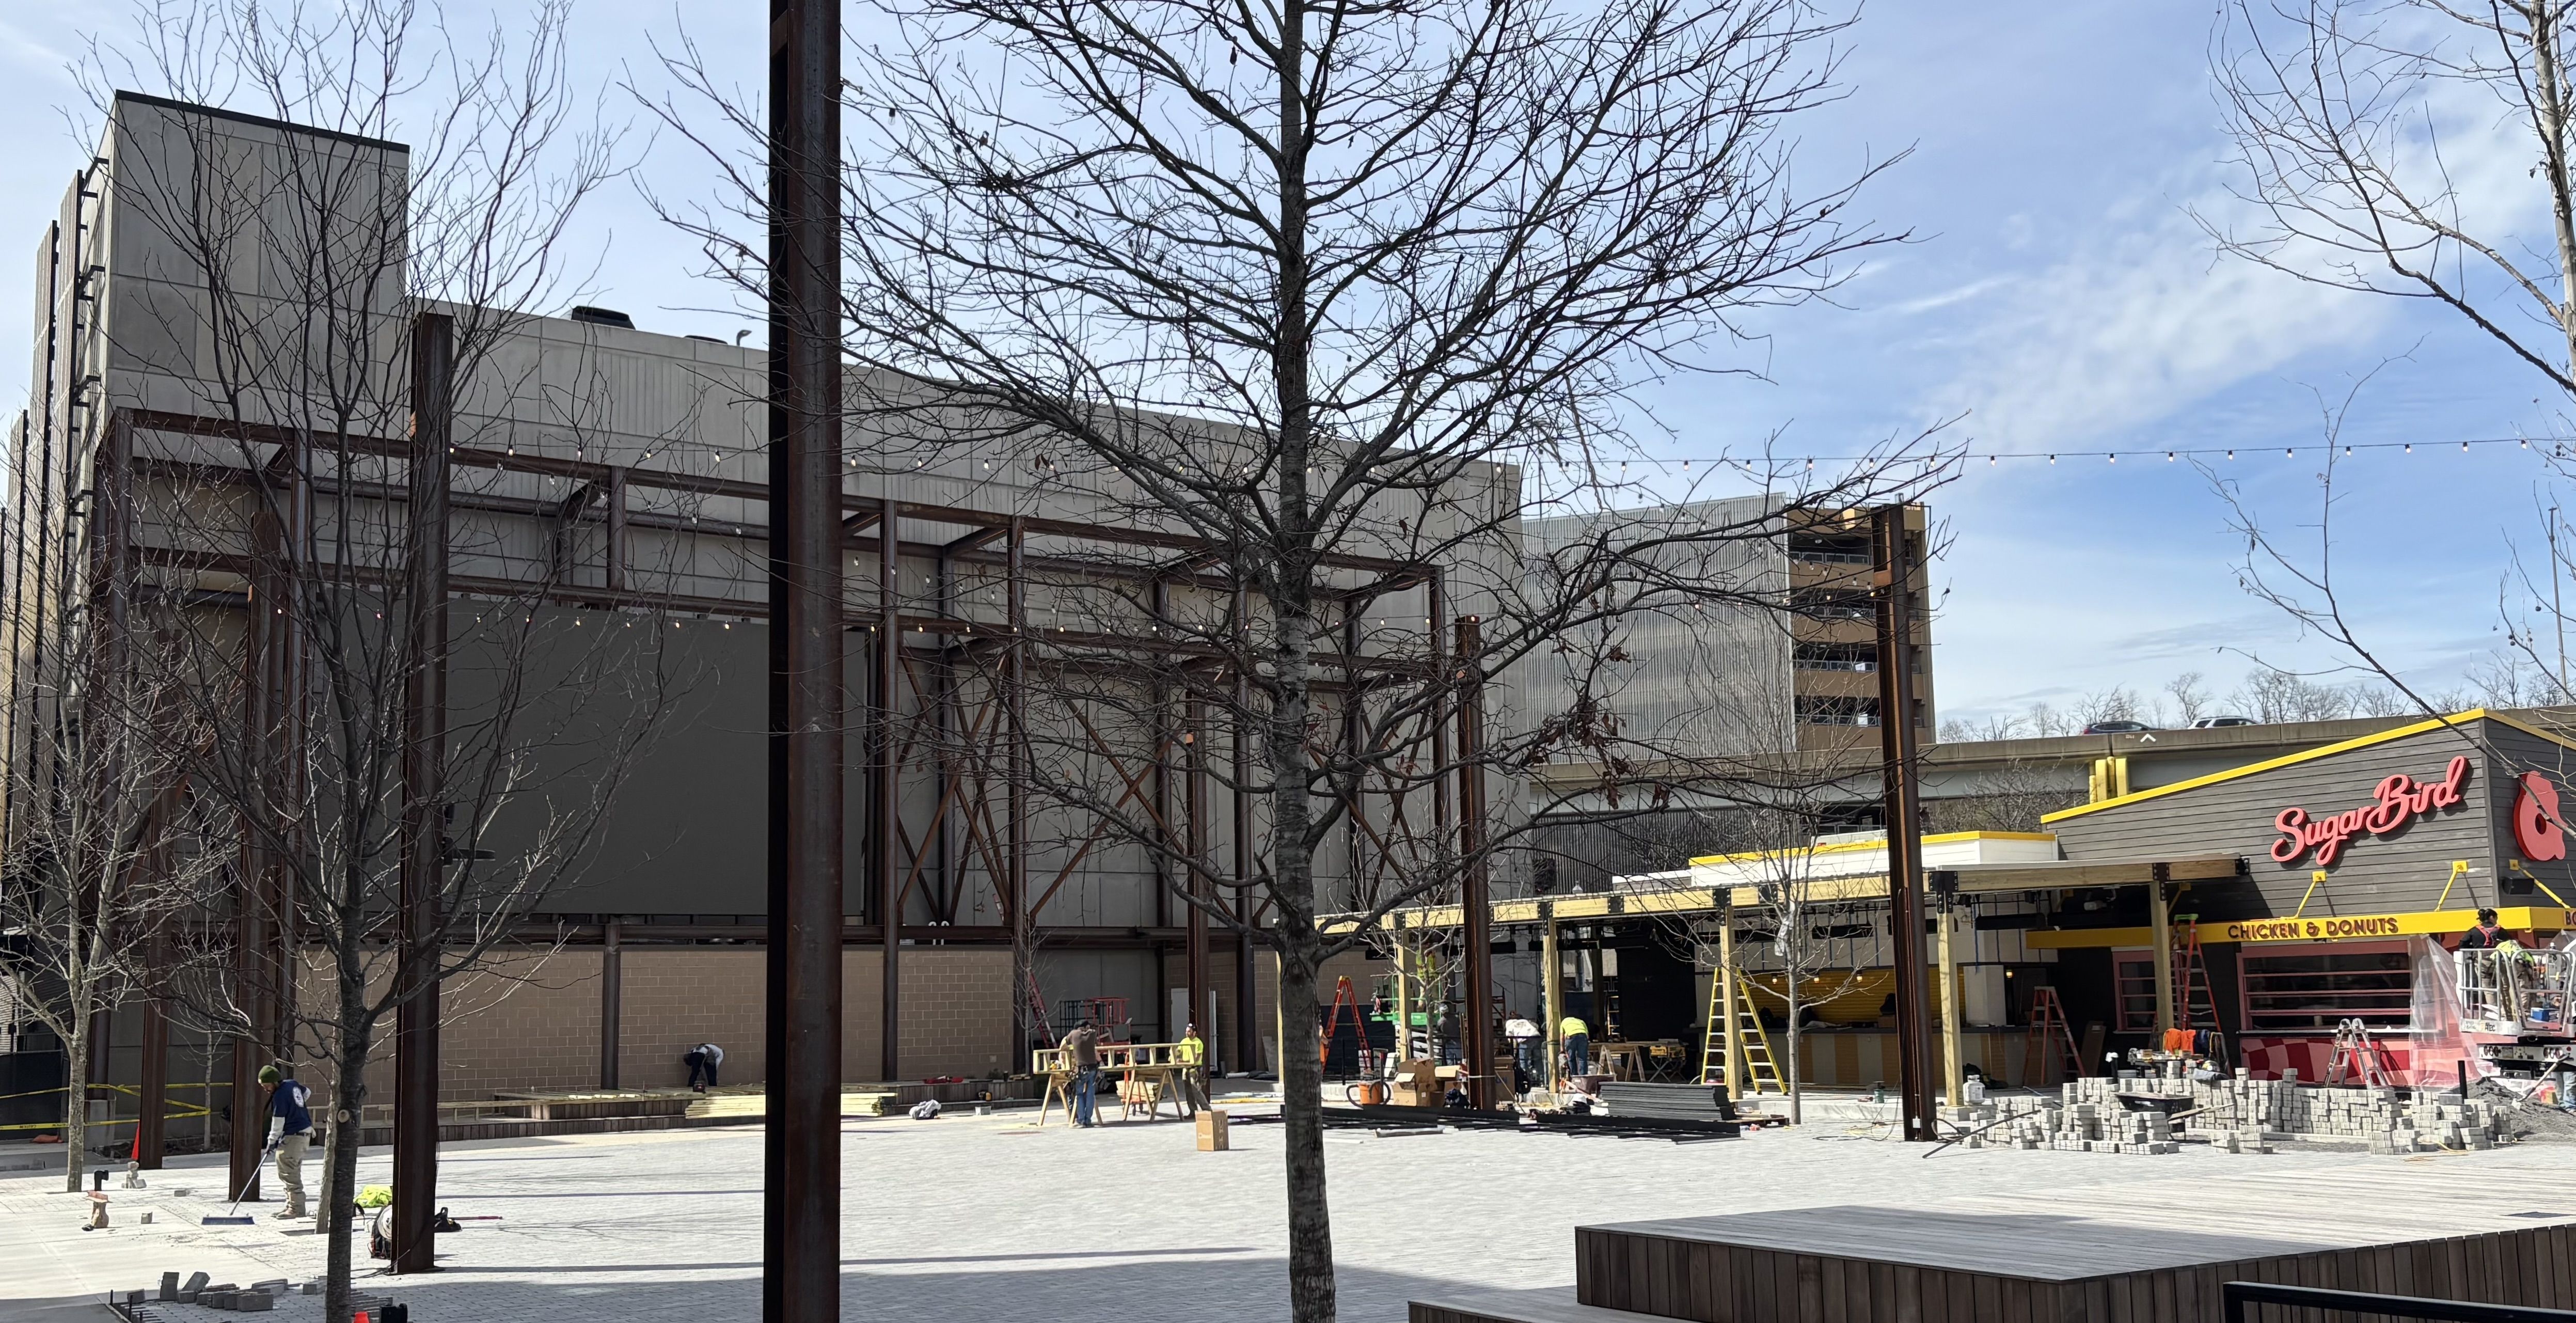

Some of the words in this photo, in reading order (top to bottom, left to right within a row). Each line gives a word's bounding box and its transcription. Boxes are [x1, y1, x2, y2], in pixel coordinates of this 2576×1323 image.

[2228, 922, 2300, 939] CHICKEN
[2306, 922, 2320, 937] &
[2326, 917, 2399, 936] DONUTS
